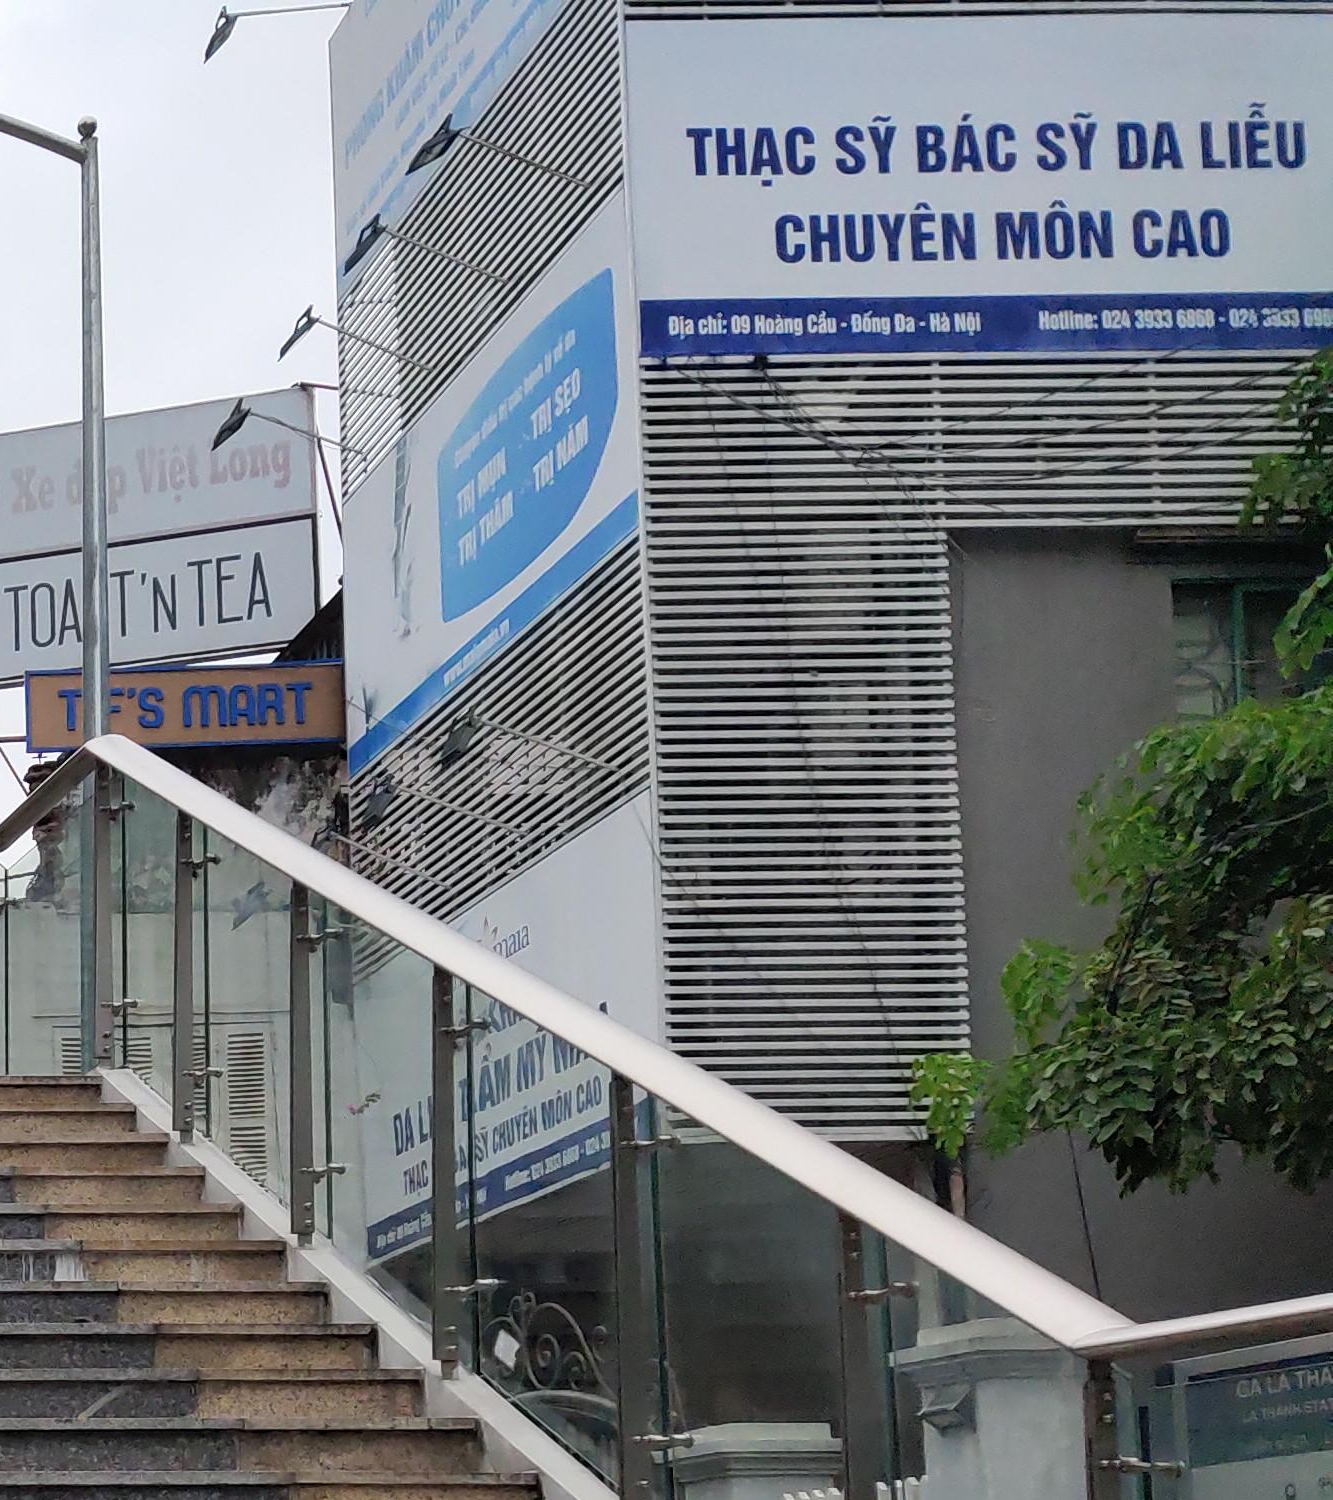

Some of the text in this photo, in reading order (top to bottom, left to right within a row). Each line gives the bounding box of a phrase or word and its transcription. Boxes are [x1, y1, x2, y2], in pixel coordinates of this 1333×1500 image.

[686, 101, 1307, 187] THẠC SỸ BÁC SỸ DA LIỄU
[774, 200, 1232, 264] CHUYÊN MÔN CAO
[730, 314, 751, 335] 09
[754, 312, 804, 337] Hoàng
[929, 312, 951, 334] Hà
[954, 311, 982, 337] Nội
[1038, 309, 1099, 331] Hotline:
[1101, 308, 1132, 329] 024
[1134, 308, 1174, 330] 3933
[9, 463, 55, 514] Xe
[135, 443, 200, 504] Việt
[208, 440, 292, 490] Long
[186, 550, 274, 628] TEA
[182, 681, 313, 728] MART
[392, 1106, 415, 1157] DA
[403, 1159, 429, 1197] THẠC
[491, 1105, 539, 1155] CHUYÊN
[540, 1089, 573, 1132] MÔN
[575, 1074, 603, 1115] CAO
